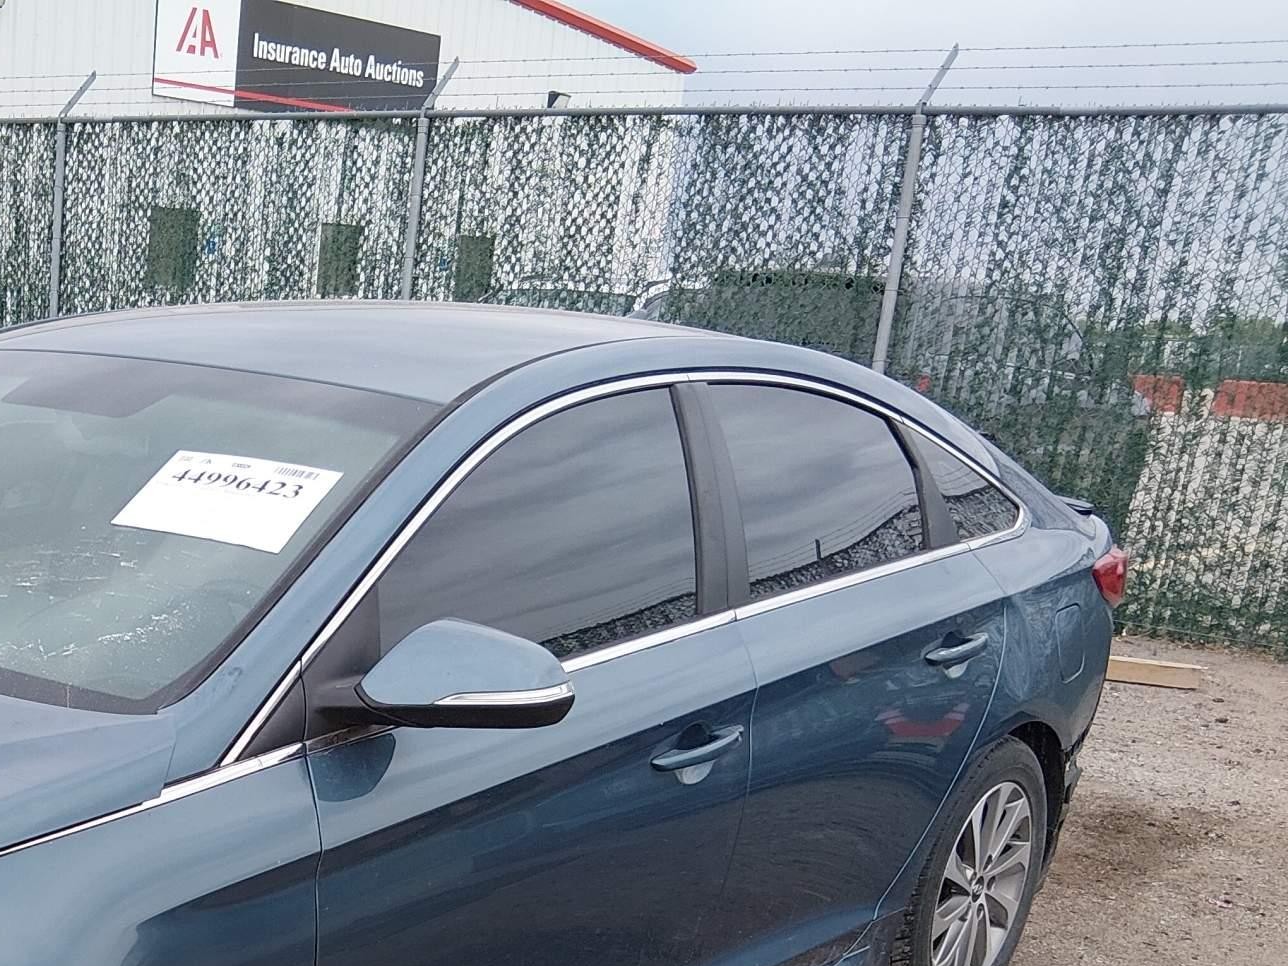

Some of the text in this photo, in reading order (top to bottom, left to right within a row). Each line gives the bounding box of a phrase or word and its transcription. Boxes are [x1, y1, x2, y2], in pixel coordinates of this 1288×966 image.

[252, 32, 424, 88] Insurance Auto Auctions
[172, 468, 304, 499] 44996423
